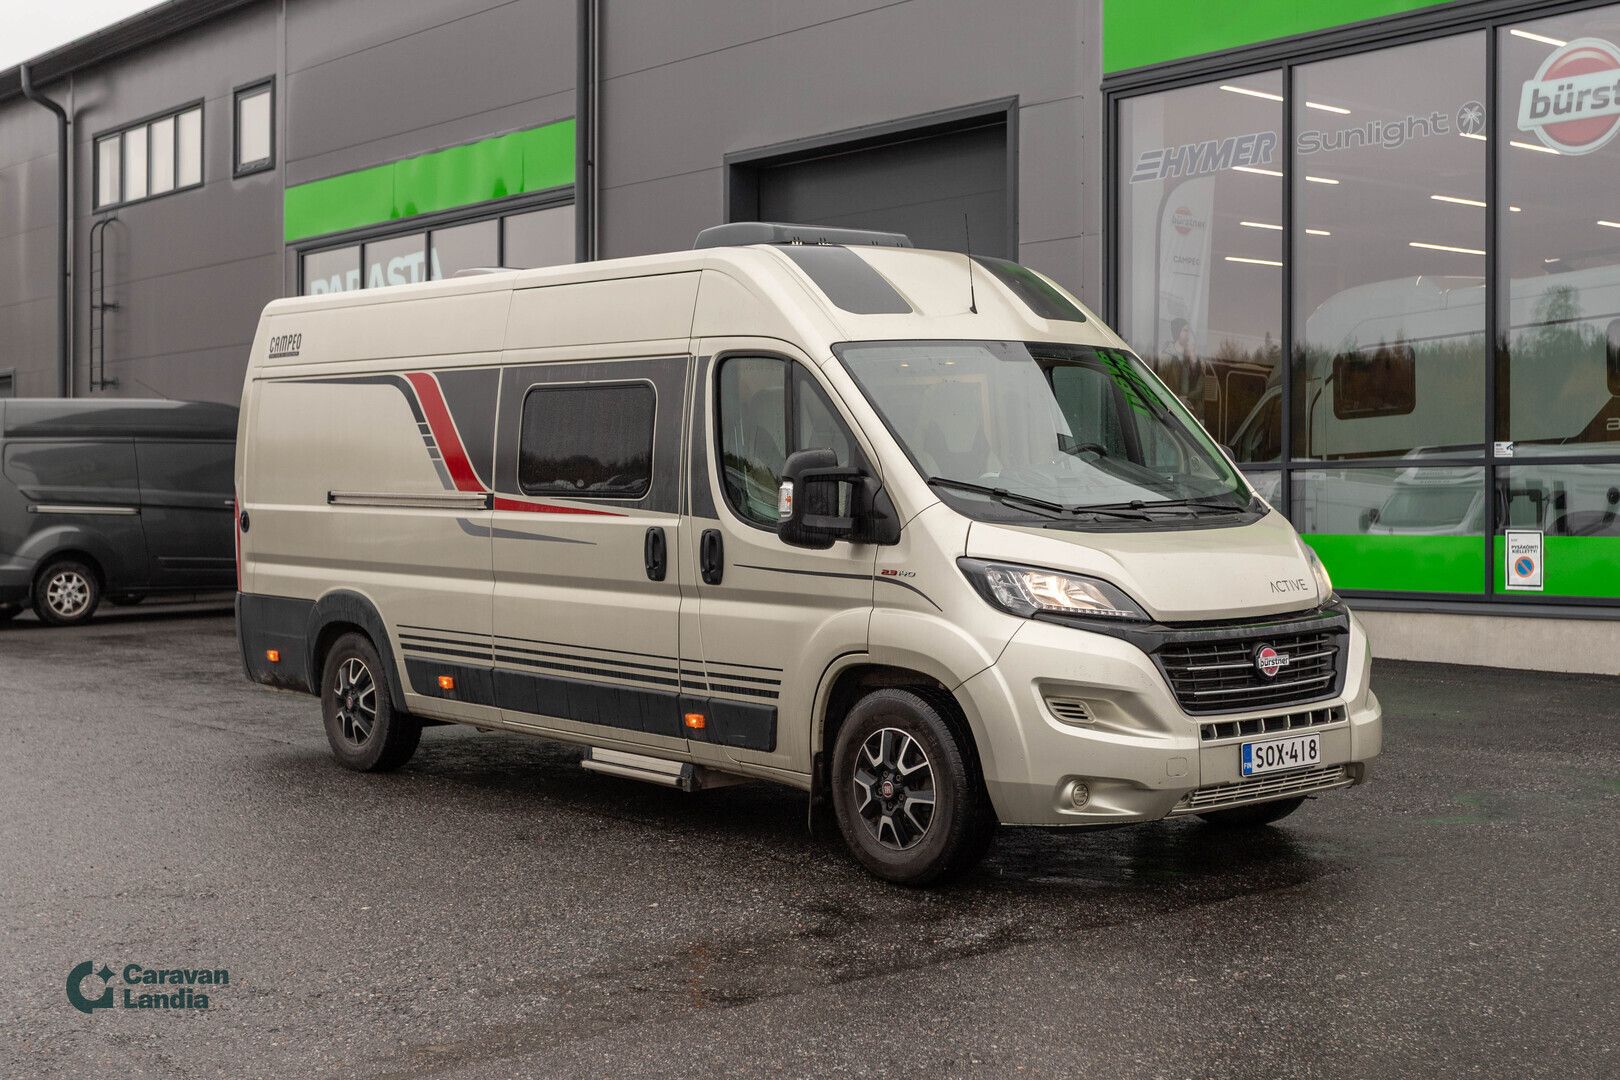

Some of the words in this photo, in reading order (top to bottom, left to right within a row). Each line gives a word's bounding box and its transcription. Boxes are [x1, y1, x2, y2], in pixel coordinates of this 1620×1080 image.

[1297, 111, 1450, 155] Sunlight
[1157, 130, 1277, 178] HYMER
[269, 332, 302, 353] CAMPEO
[1270, 578, 1308, 594] ACTIVE
[1259, 655, 1289, 668] bürstner
[1255, 738, 1317, 769] SOX-418
